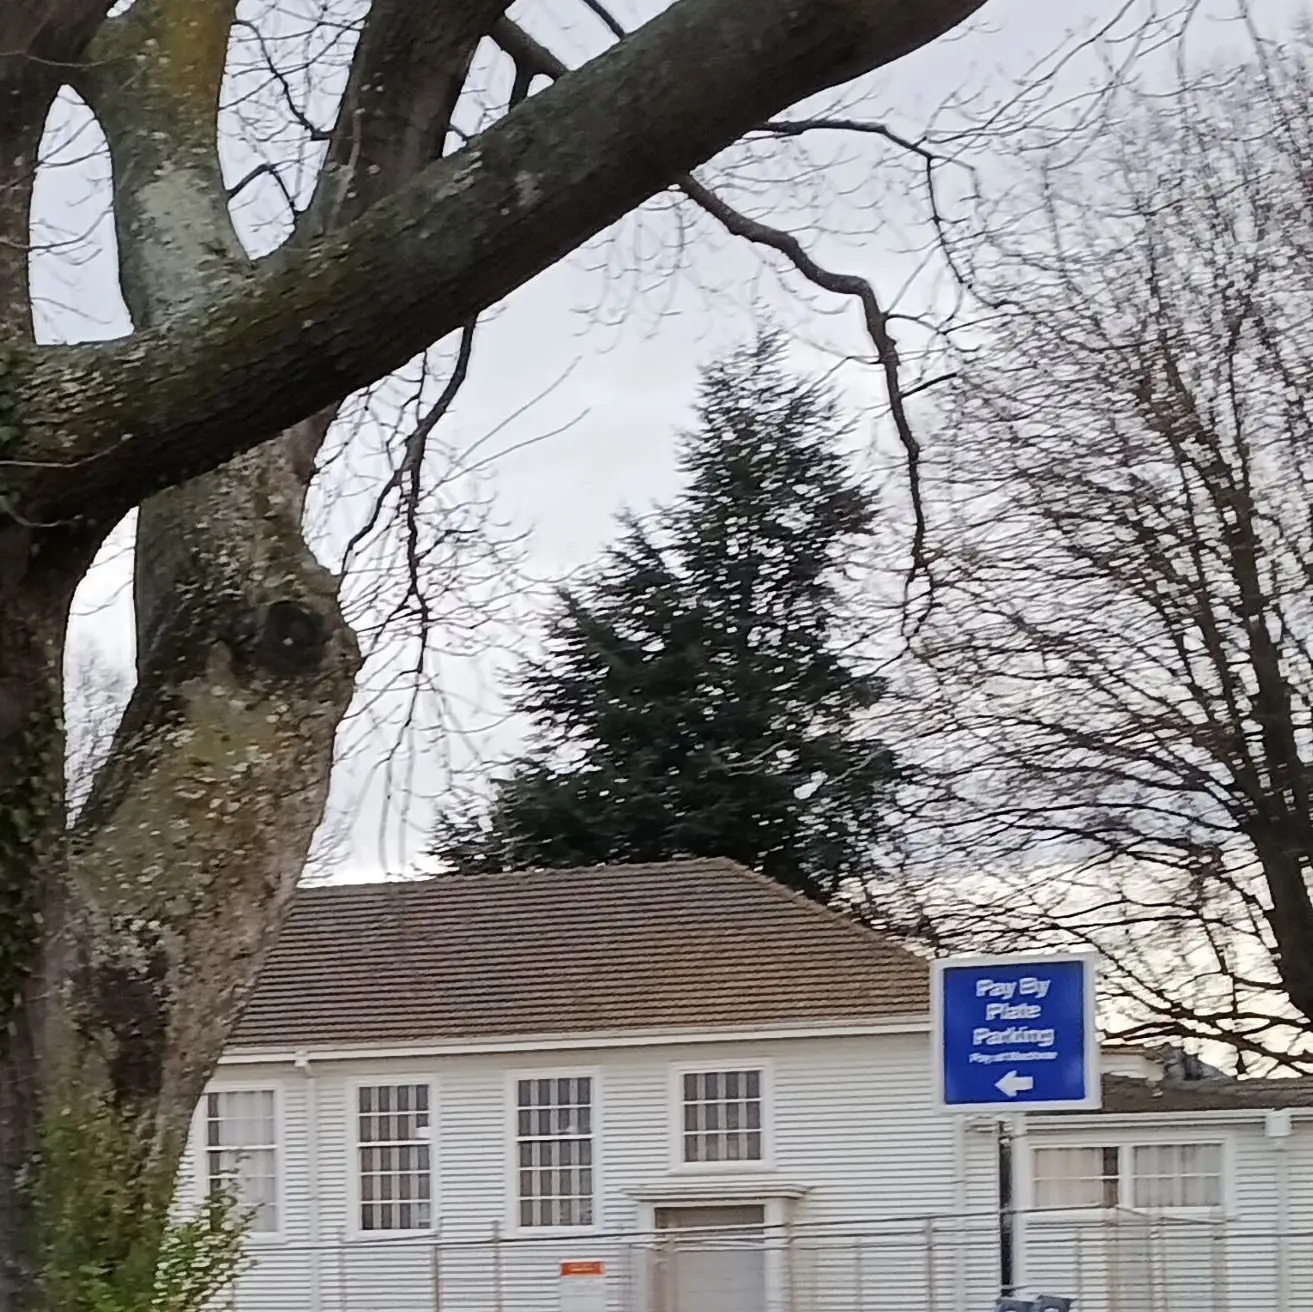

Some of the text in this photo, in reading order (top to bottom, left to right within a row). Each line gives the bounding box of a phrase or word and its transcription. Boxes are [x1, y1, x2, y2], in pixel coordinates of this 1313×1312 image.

[975, 977, 1051, 1000] Pay By
[985, 1003, 1042, 1021] Plate
[972, 1026, 1055, 1047] Parking
